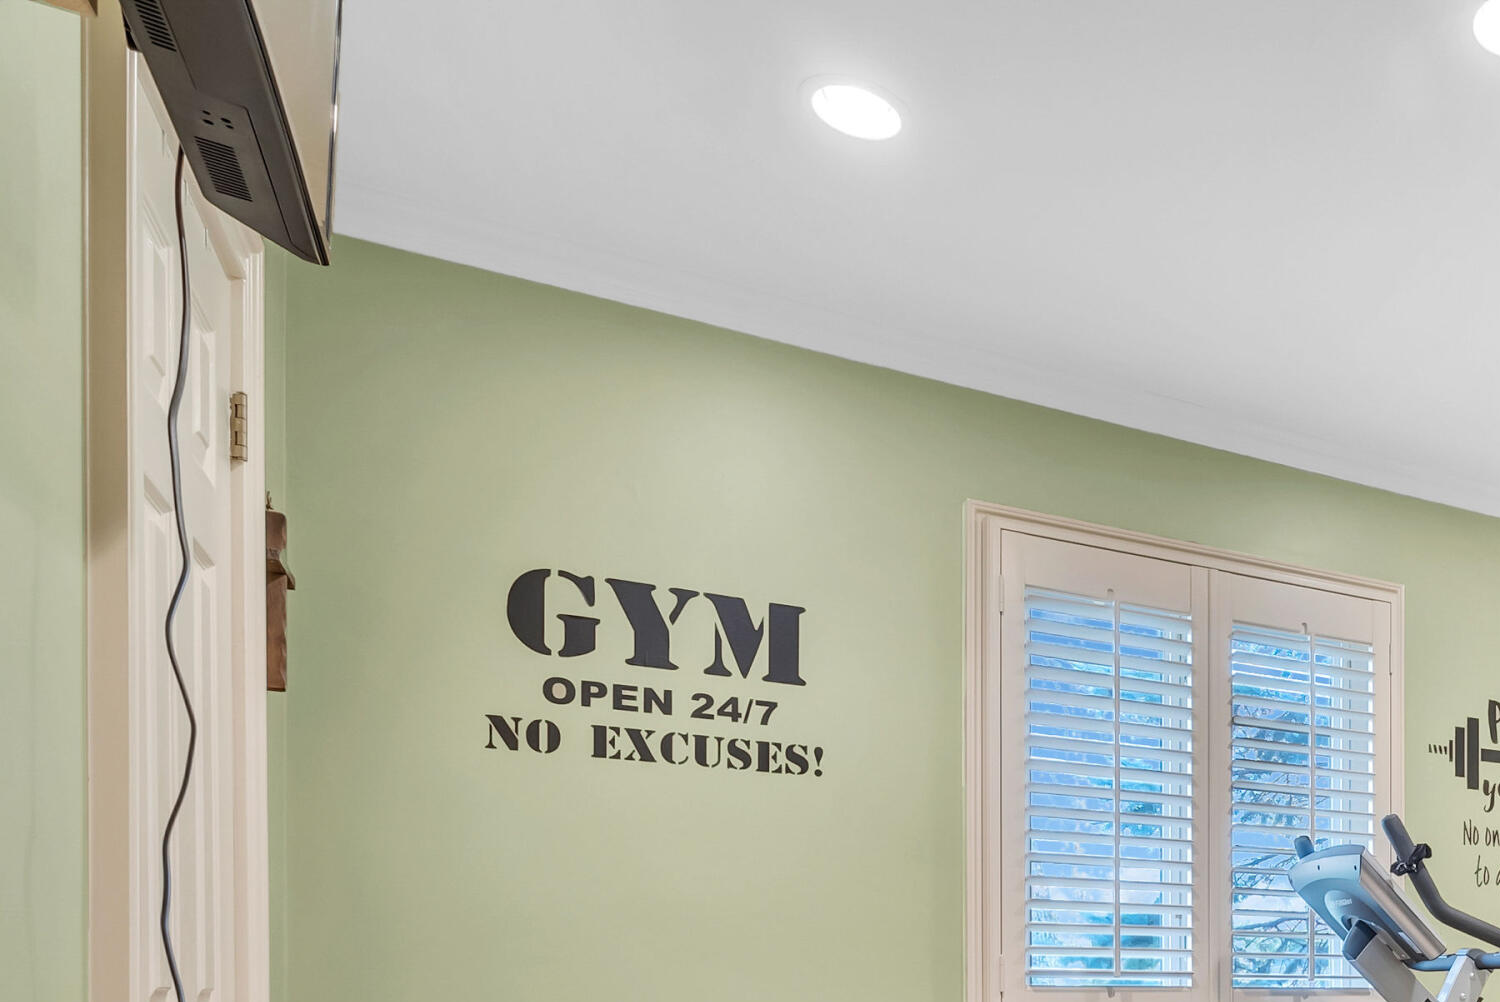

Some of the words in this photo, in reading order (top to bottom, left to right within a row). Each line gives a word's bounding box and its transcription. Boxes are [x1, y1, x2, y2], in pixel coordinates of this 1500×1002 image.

[506, 568, 807, 687] GYM
[542, 676, 673, 716] OPEN
[690, 692, 778, 726] 24/7
[484, 714, 562, 754] NO
[590, 724, 824, 778] EXCUSES!
[1463, 818, 1480, 846] No
[1474, 854, 1491, 888] to
